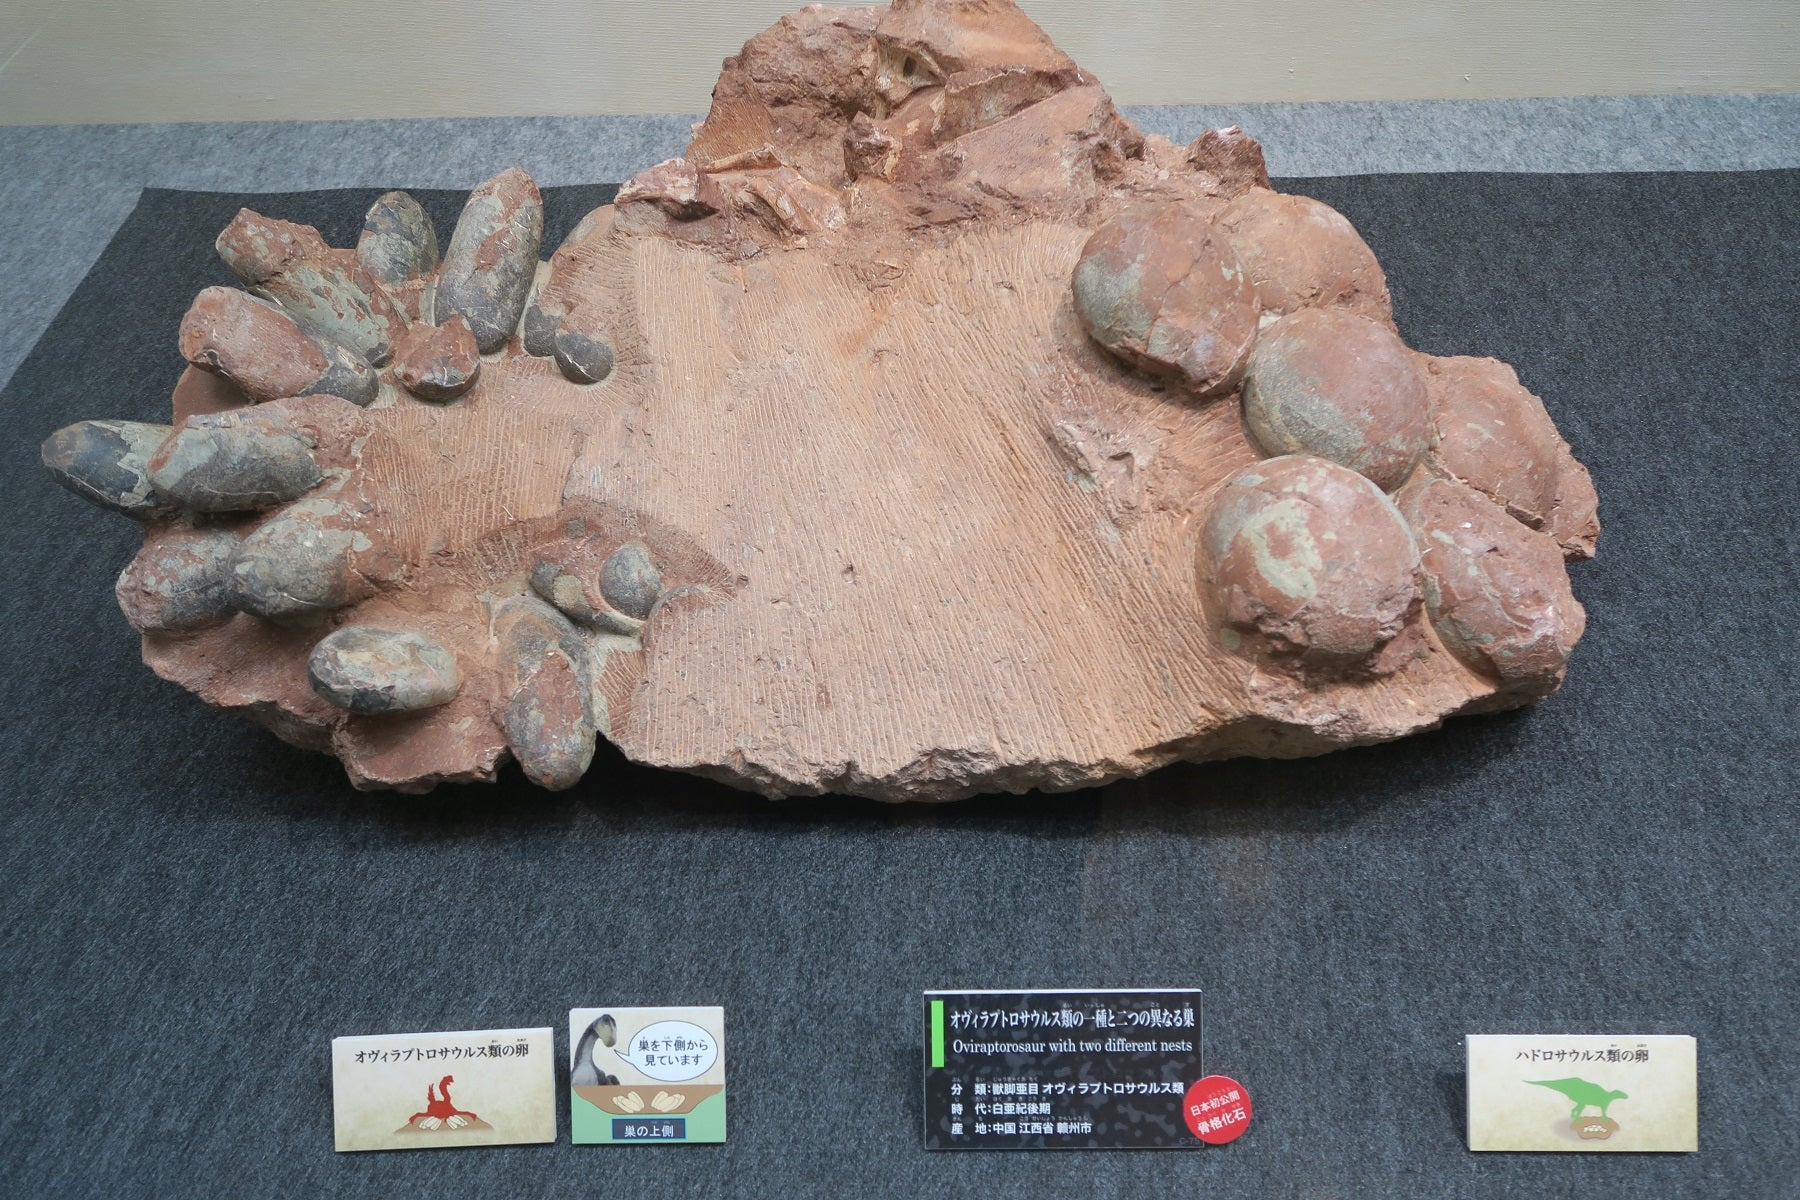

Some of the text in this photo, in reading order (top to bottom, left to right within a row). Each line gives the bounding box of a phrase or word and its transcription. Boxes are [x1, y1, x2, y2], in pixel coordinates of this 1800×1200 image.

[355, 1043, 529, 1063] オヴィラプトロサウルス類の卵
[638, 1040, 709, 1052] 巣を下側から
[953, 1038, 1193, 1055] Oviraptorosaur with two different nests
[644, 1054, 702, 1066] 見ています
[1515, 1048, 1649, 1063] ハドロサウルス類の卵
[1190, 1090, 1240, 1116] 日本初公開
[1019, 1122, 1054, 1134] 江西省
[1198, 1107, 1247, 1135] 骨格化石
[624, 1125, 674, 1137] 巣の上側
